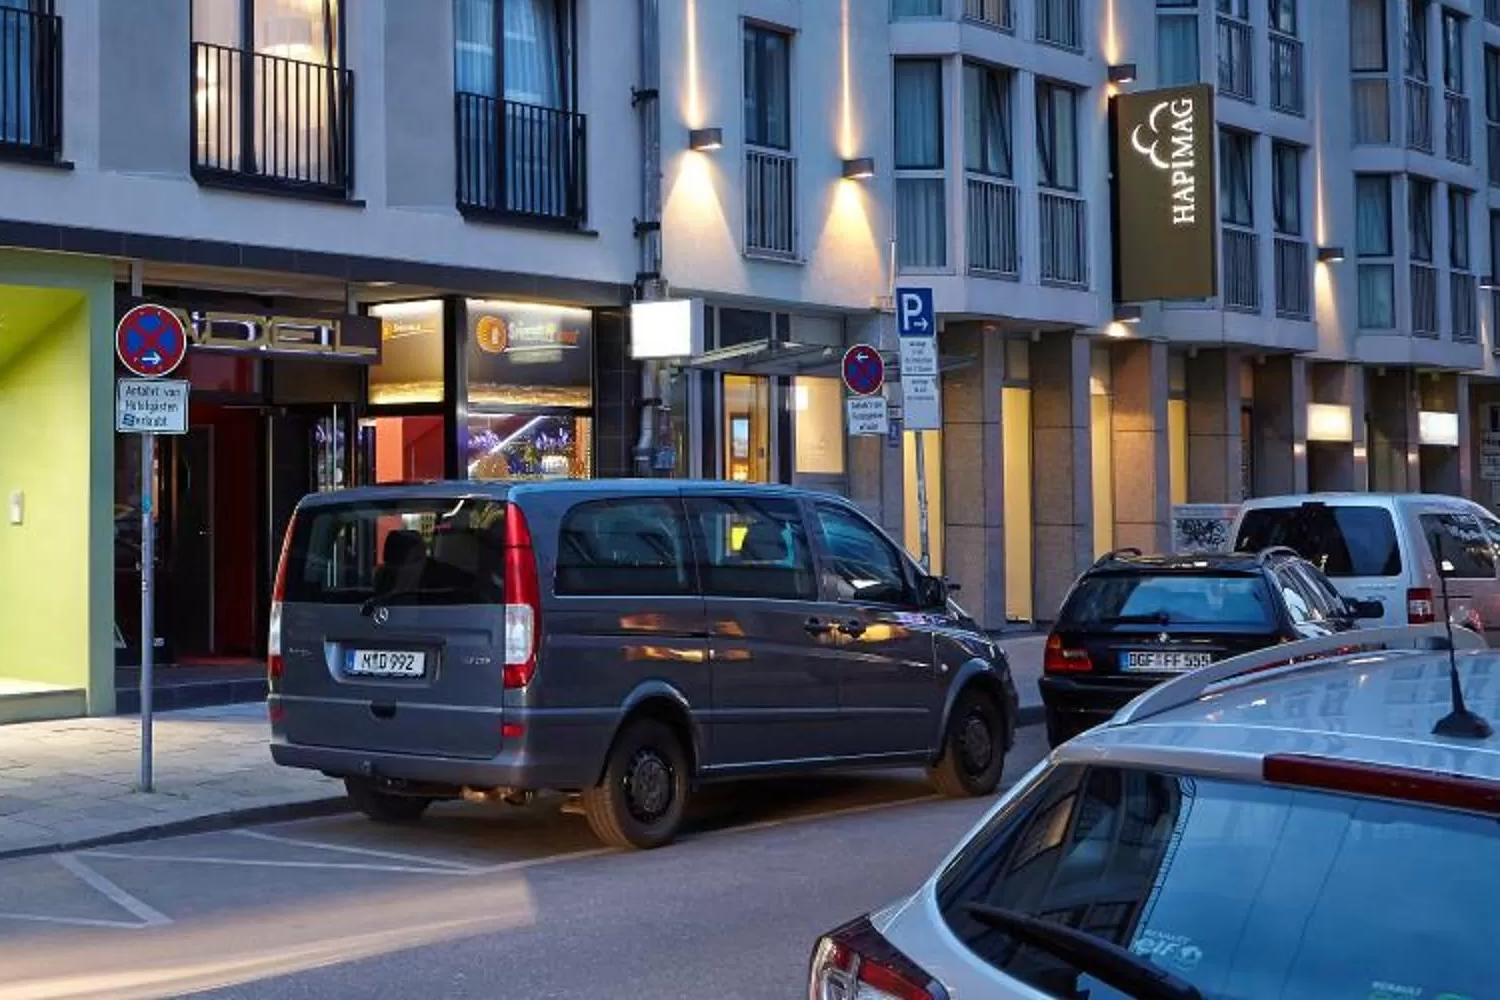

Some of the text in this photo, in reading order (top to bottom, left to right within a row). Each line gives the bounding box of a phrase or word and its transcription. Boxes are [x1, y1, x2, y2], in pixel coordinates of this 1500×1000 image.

[1171, 98, 1196, 225] HAPIMAG
[902, 293, 923, 331] P
[389, 654, 415, 671] 992
